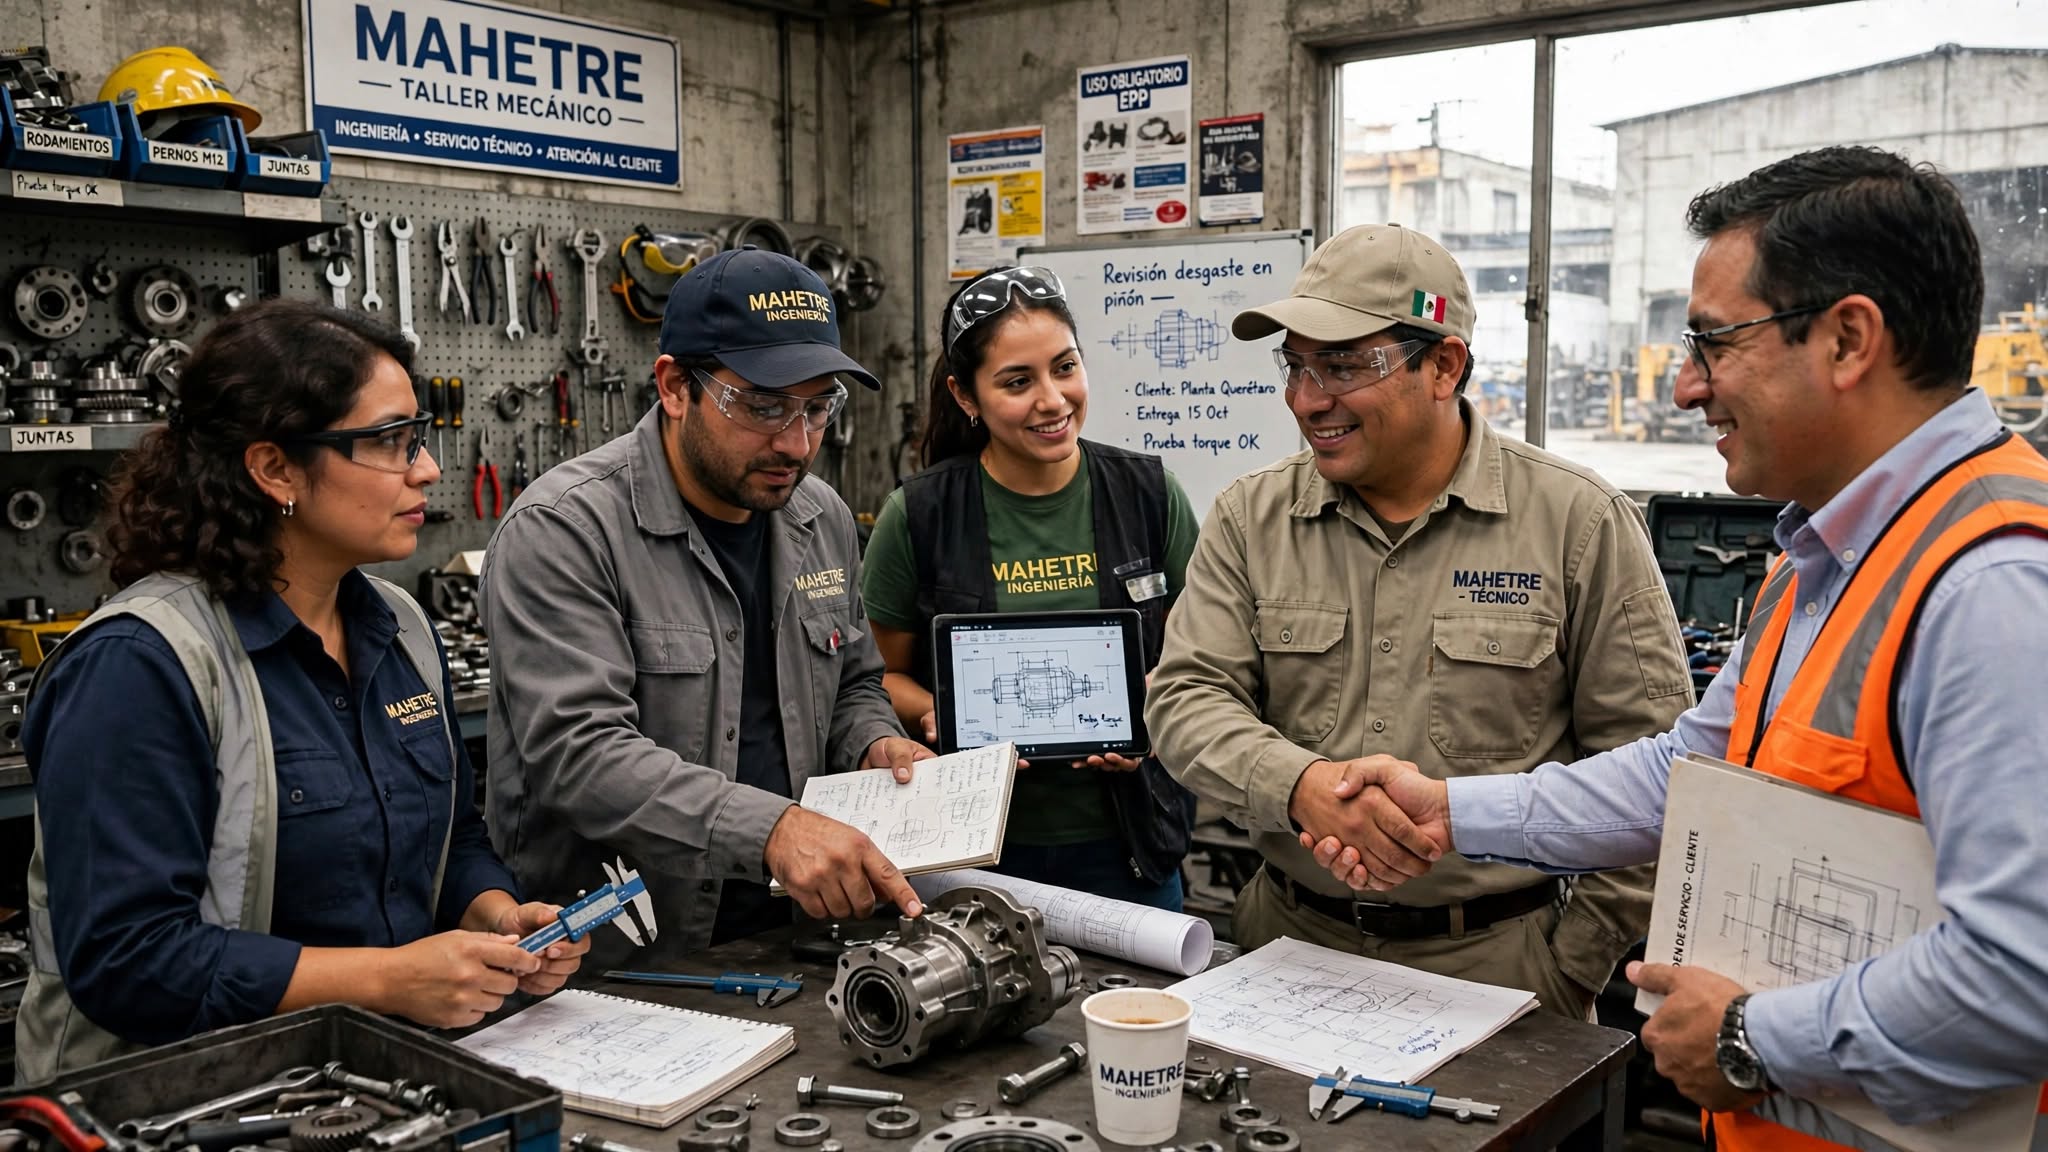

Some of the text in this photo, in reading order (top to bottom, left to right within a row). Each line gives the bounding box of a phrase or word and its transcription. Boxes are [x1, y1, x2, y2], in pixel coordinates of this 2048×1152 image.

[355, 3, 644, 103] MAHETRE
[1086, 66, 1183, 93] USO OBLIGATORIO
[400, 78, 612, 127] TALLER MECÁNICO
[1119, 89, 1148, 110] EPP
[27, 131, 110, 154] RODAMIENTOS
[335, 119, 662, 173] INGENIERÍA SERVICIO TÉCNICO ATENCIÓN AL CLIENTE
[153, 146, 224, 166] PERNOS M12
[267, 159, 310, 176] JUNTAS
[1103, 258, 1272, 286] Revisión desgaste en
[748, 290, 831, 313] MAHETRE
[1104, 289, 1144, 315] piñón
[1134, 379, 1276, 397] Cliente: Planta Querétaro
[1137, 405, 1229, 426] Entrega 15 Oct
[17, 430, 74, 444] JUNTAS
[1143, 433, 1260, 456] Prueba torque OK
[794, 568, 846, 591] MAHETRE
[1007, 573, 1094, 594] INGENIERÍA
[1453, 570, 1542, 590] MAHETRE
[1469, 588, 1529, 605] TÉCNICO
[1685, 829, 1699, 874] CLIENTE
[1677, 882, 1693, 931] SERVICIO
[1674, 931, 1686, 947] DE
[1100, 1060, 1184, 1087] MAHETRE
